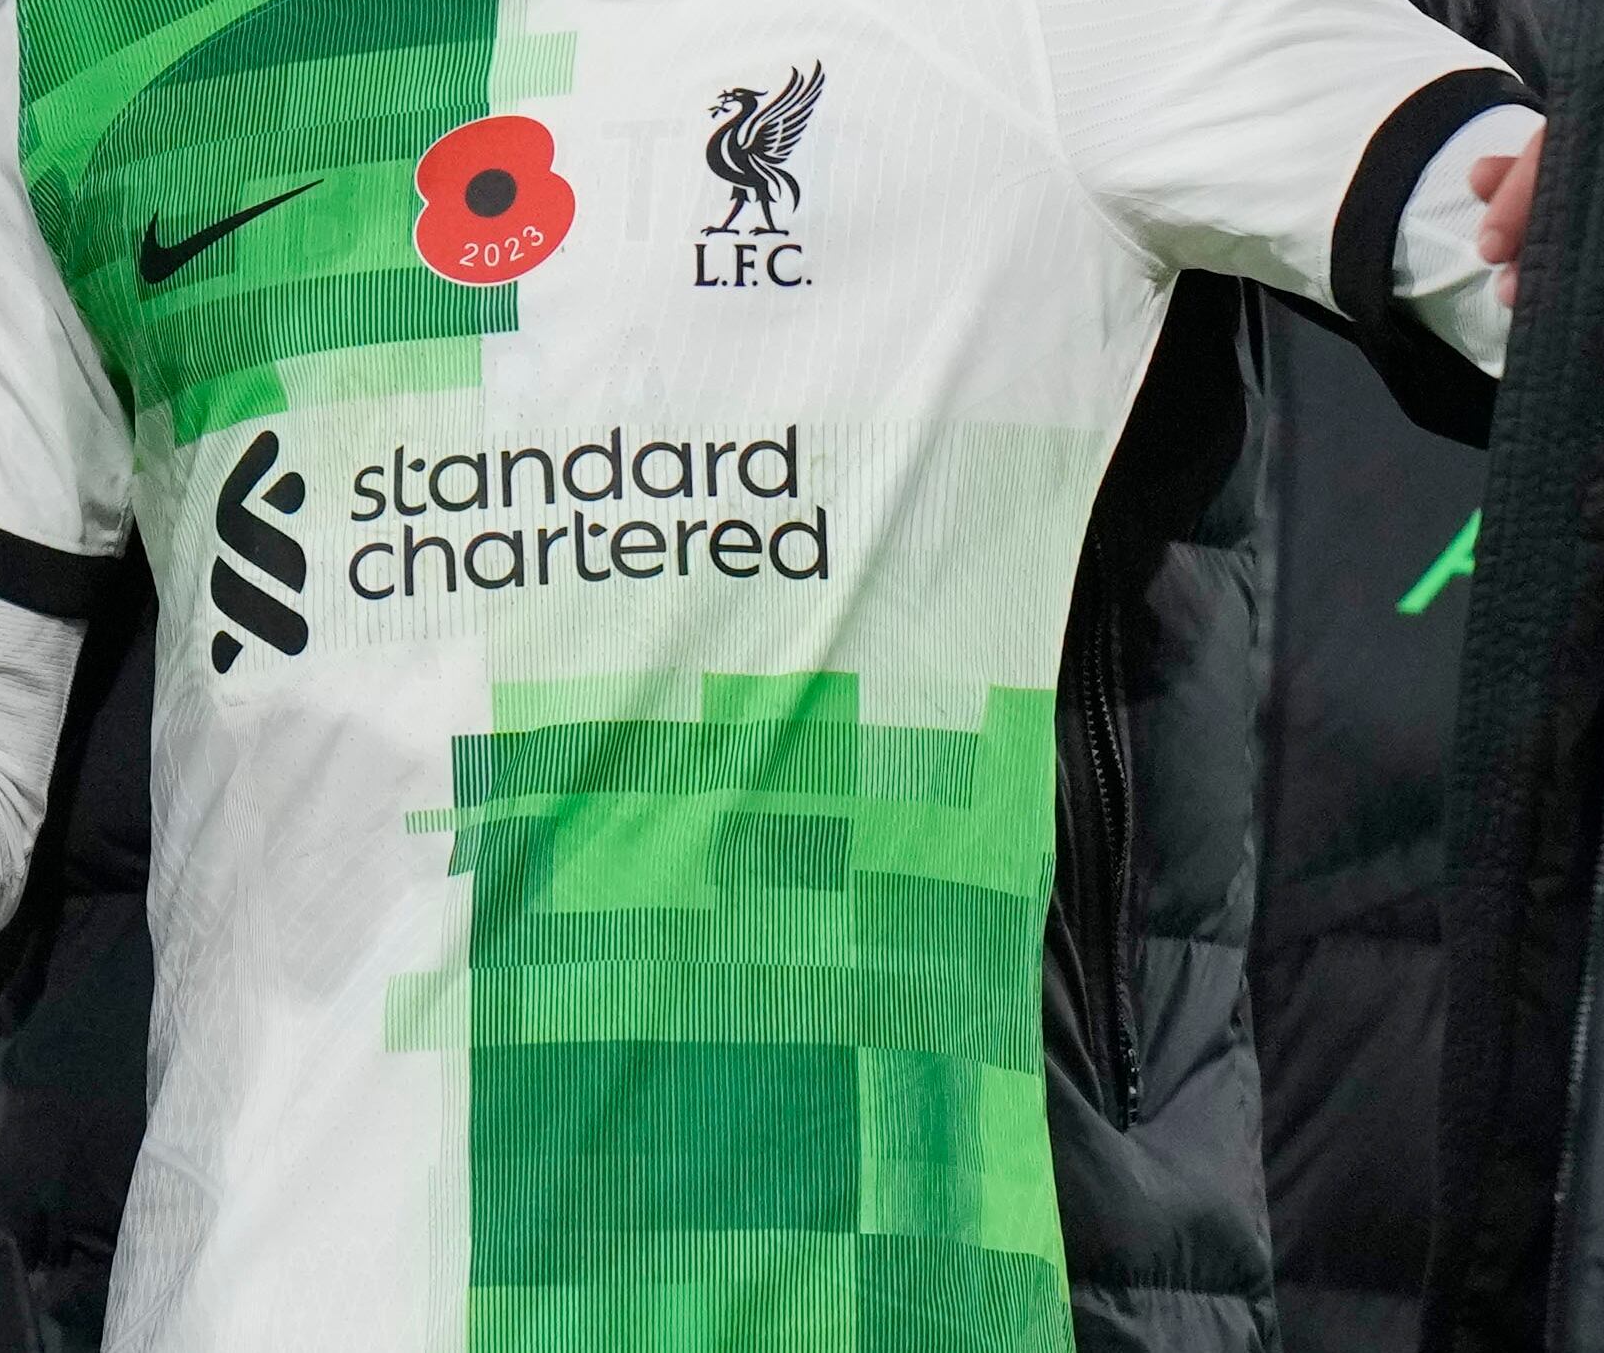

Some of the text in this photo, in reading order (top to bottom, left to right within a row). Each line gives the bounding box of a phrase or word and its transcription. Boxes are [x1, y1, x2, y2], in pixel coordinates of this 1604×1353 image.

[459, 224, 545, 268] 2023
[693, 243, 812, 287] L.F.C.
[350, 423, 798, 522] standard
[348, 506, 829, 600] chartered
